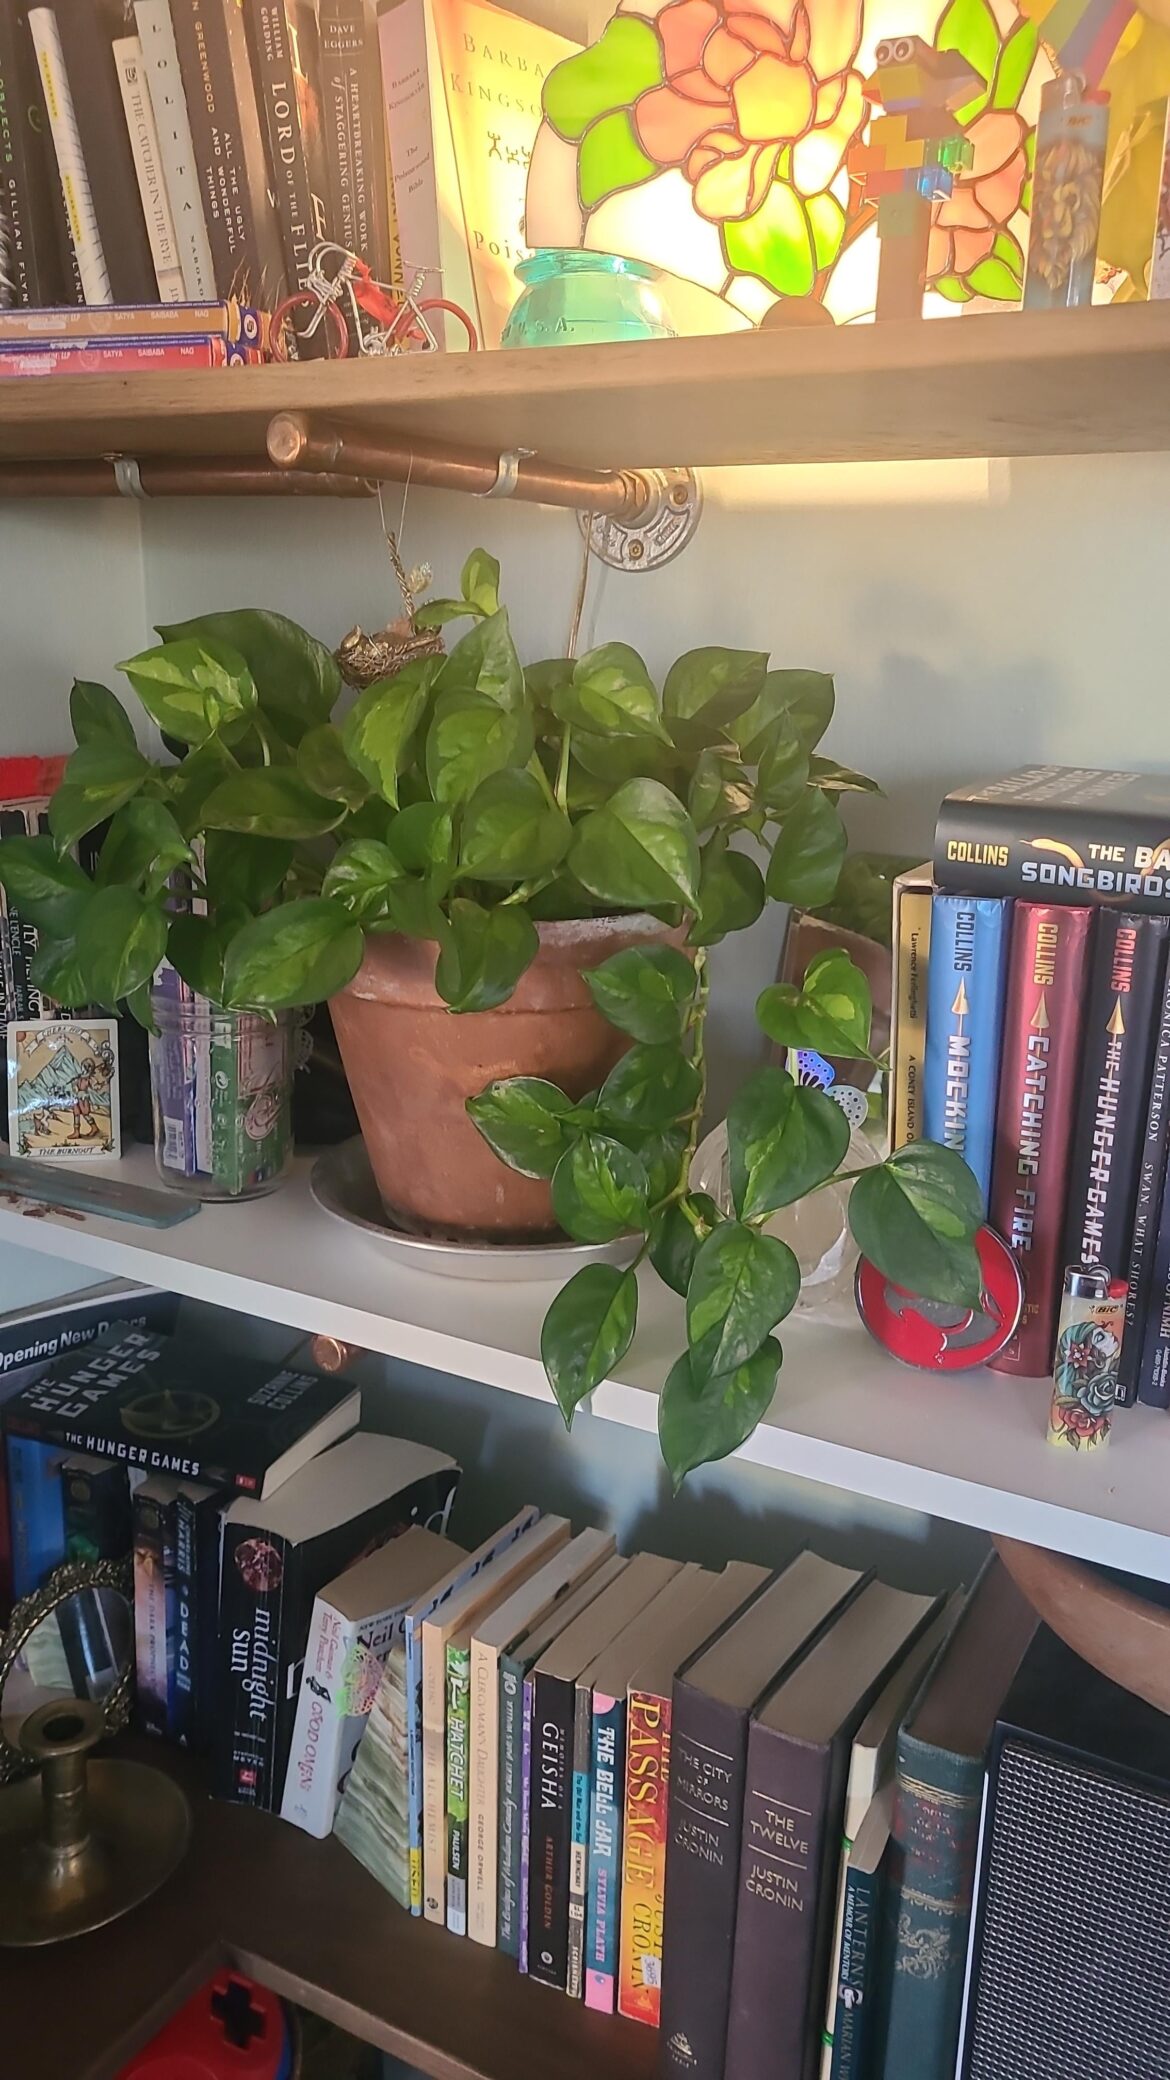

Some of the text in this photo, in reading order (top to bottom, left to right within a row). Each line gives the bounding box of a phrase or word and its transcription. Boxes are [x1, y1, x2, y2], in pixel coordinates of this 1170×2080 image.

[260, 7, 274, 62] GOLDING
[324, 39, 364, 49] EGGERS
[329, 24, 355, 34] DAVE
[195, 22, 215, 113] GREENWOOD
[152, 24, 192, 211] LOLITA
[132, 91, 173, 264] THE CATCHER IN THE RYE
[331, 75, 353, 248] of STAGGERING GENIUS
[349, 68, 368, 252] A HEARTBREAKING WORK
[205, 166, 220, 219] THINGS
[211, 127, 236, 254] AND WONDERFUL
[224, 133, 246, 241] ALL THE UGLY
[271, 81, 310, 292] LORD OF THE FLIE
[9, 179, 29, 303] GILLIAN FLYN
[190, 234, 206, 301] NABOKO
[115, 310, 208, 320] SATYA SAIBABA NAG
[103, 347, 194, 359] SATYA SAIBABA NAG
[947, 840, 1009, 867] COLLINS
[1088, 843, 1126, 862] THE
[909, 931, 919, 972] Lawrence
[953, 911, 975, 972] COLLINS
[1034, 922, 1058, 986] COLLINS
[1111, 928, 1137, 993] COLLINS
[907, 1054, 917, 1062] A
[907, 1064, 917, 1095] CONEY
[906, 1098, 916, 1129] ISLAND
[1149, 1055, 1168, 1142] PATTERSON
[39, 1146, 95, 1156] THE BURNOUT
[1011, 1035, 1050, 1252] CATCHING FIRE
[1081, 1039, 1122, 1265] THE HUNGER GAMES
[1131, 1214, 1147, 1257] WHAT
[1096, 1304, 1119, 1315] BIC
[1124, 1260, 1142, 1327] SHORES?
[60, 1328, 95, 1347] New
[98, 1315, 147, 1336] Drs
[21, 1378, 57, 1399] THE
[30, 1332, 151, 1411] HUNGER
[55, 1347, 161, 1419] GAMES
[65, 1431, 200, 1477] THE HUNGER GAMES
[177, 1517, 186, 1573] HARRIS
[178, 1601, 190, 1671] DEAD
[230, 1627, 251, 1673] sun
[356, 1621, 395, 1650] Neil
[476, 1651, 488, 1663] A
[241, 1607, 277, 1722] midnight
[450, 1717, 465, 1801] HATCHET
[678, 1747, 733, 1785] THE CITY
[696, 1775, 710, 1786] OF
[625, 1695, 662, 1891] PASSAGE
[677, 1776, 730, 1812] MIRRORS
[476, 1813, 485, 1853] GEORGE
[541, 1722, 560, 1930] GEISHA ARTHUR GOLDEN
[679, 1819, 720, 1848] JUSTIN
[750, 1819, 809, 1855] TWELVE
[765, 1809, 796, 1832] THE
[452, 1829, 461, 1871] PAULSEN
[593, 1726, 616, 1963] THE BELL JAR SYLVIA PLATH
[674, 1834, 724, 1866] CRONIN
[476, 1853, 485, 1892] ORWELL
[751, 1864, 799, 1894] JUSTIN
[745, 1879, 804, 1913] CRONIN
[845, 1894, 855, 1928] MEMOIR
[850, 1887, 871, 1988] LANTERNS
[842, 1943, 852, 1984] MENTORS
[840, 2009, 854, 2060] MARIAN
